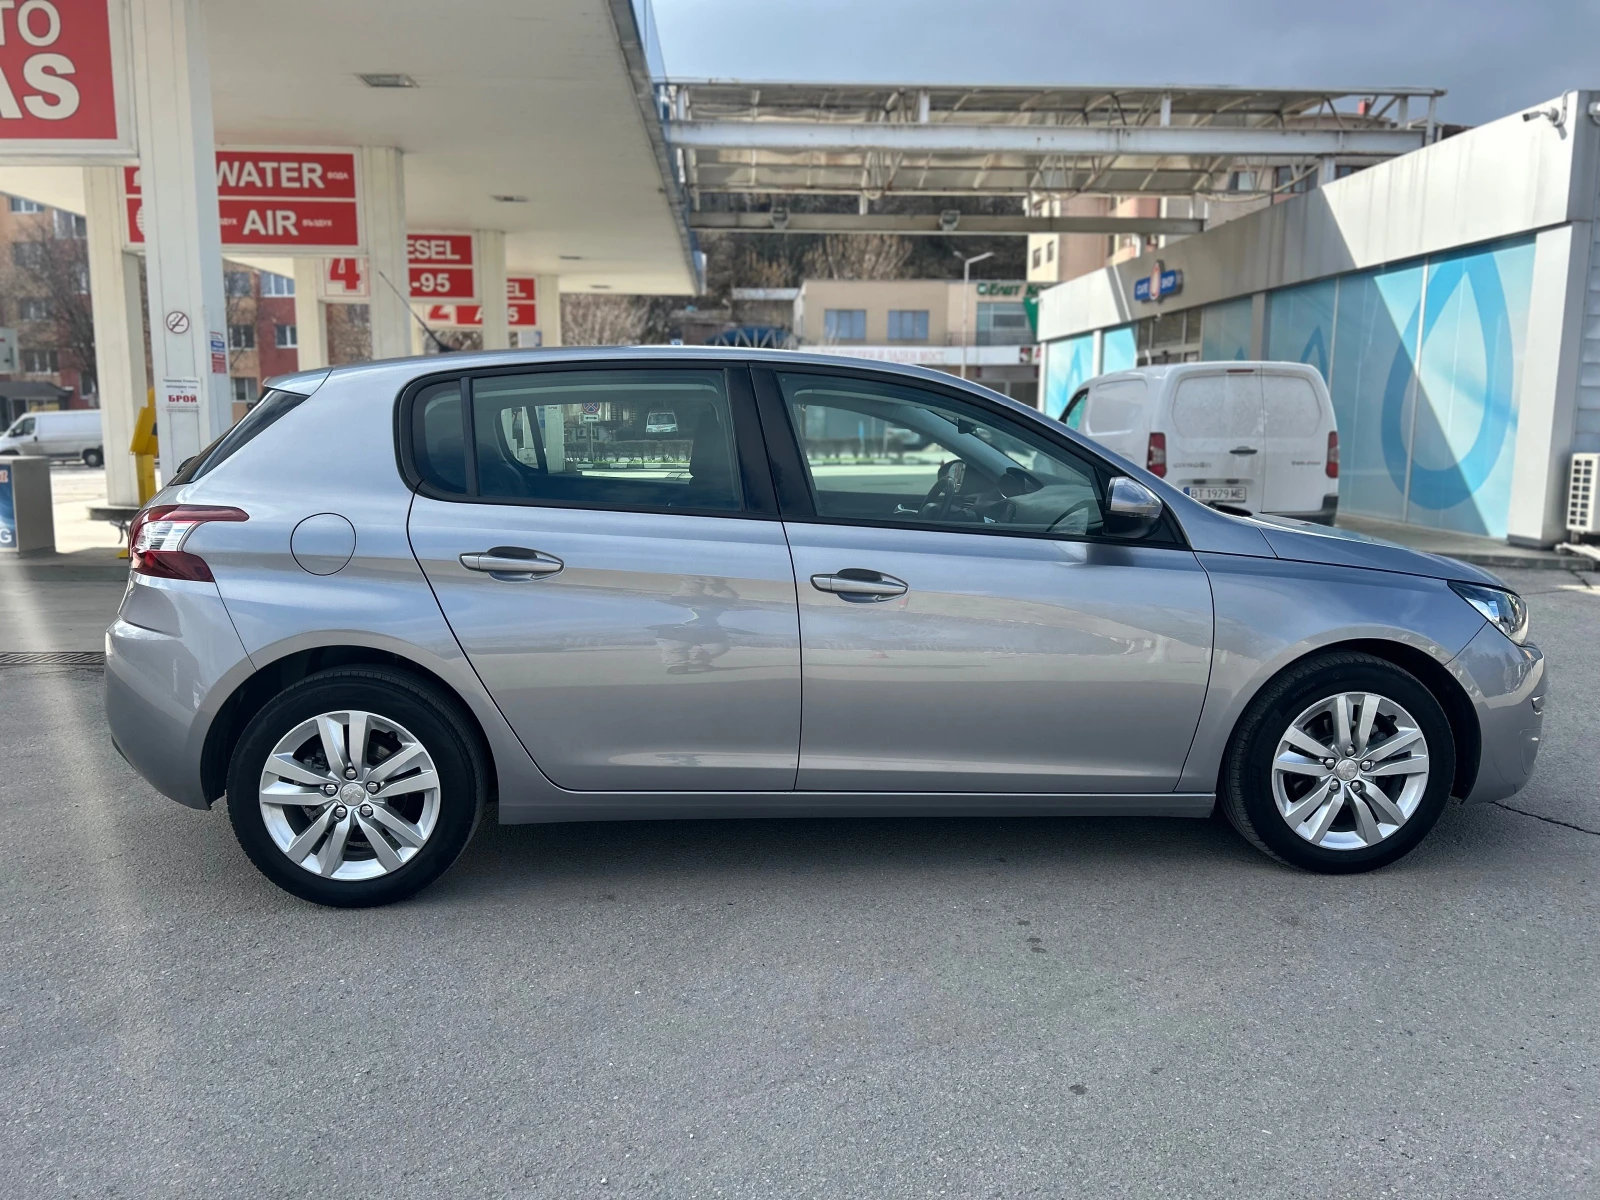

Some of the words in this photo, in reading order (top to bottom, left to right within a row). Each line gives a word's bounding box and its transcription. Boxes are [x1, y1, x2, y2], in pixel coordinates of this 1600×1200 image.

[216, 161, 325, 188] WATER
[242, 210, 299, 236] AIR
[168, 394, 198, 403] БРОЙ
[1207, 489, 1230, 499] 1979
[1231, 489, 1244, 499] ME
